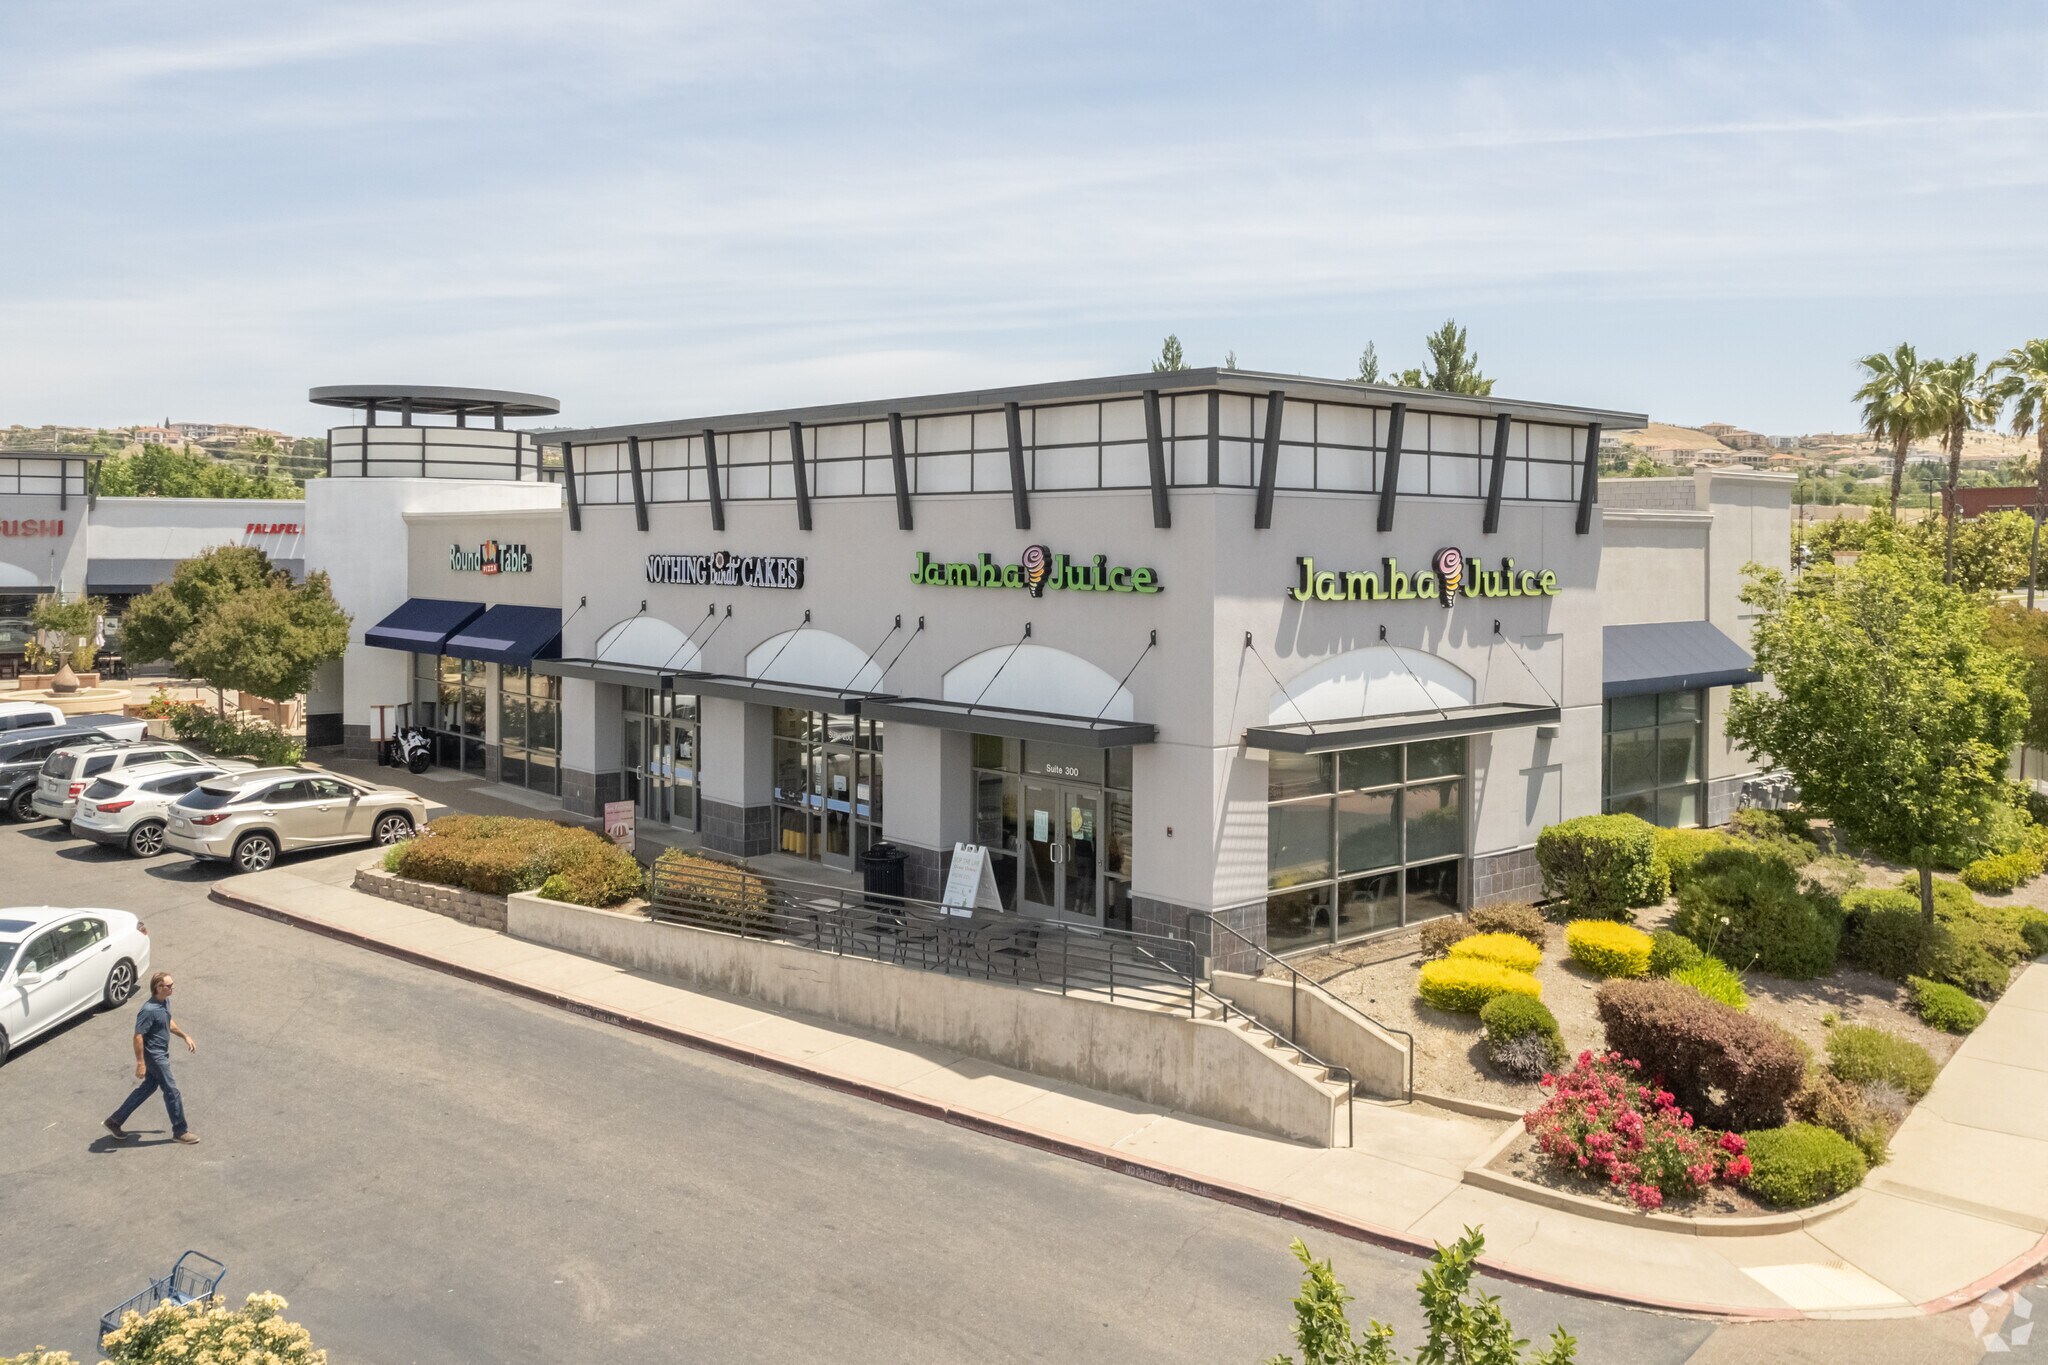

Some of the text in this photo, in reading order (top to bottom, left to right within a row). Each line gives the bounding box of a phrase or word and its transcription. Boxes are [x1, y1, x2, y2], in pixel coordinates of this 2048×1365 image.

[0, 519, 64, 537] USHI
[246, 523, 300, 535] FALAFEL
[449, 544, 530, 572] Round Table
[483, 564, 498, 572] PIZZA
[645, 555, 707, 584] NOTHING
[741, 557, 799, 588] CAKES
[909, 551, 1160, 592] Jamba Juice
[1290, 556, 1562, 601] Jamba Juice
[1046, 763, 1079, 777] Suite 300
[1125, 1164, 1135, 1175] NO
[1136, 1166, 1169, 1185] PARKING
